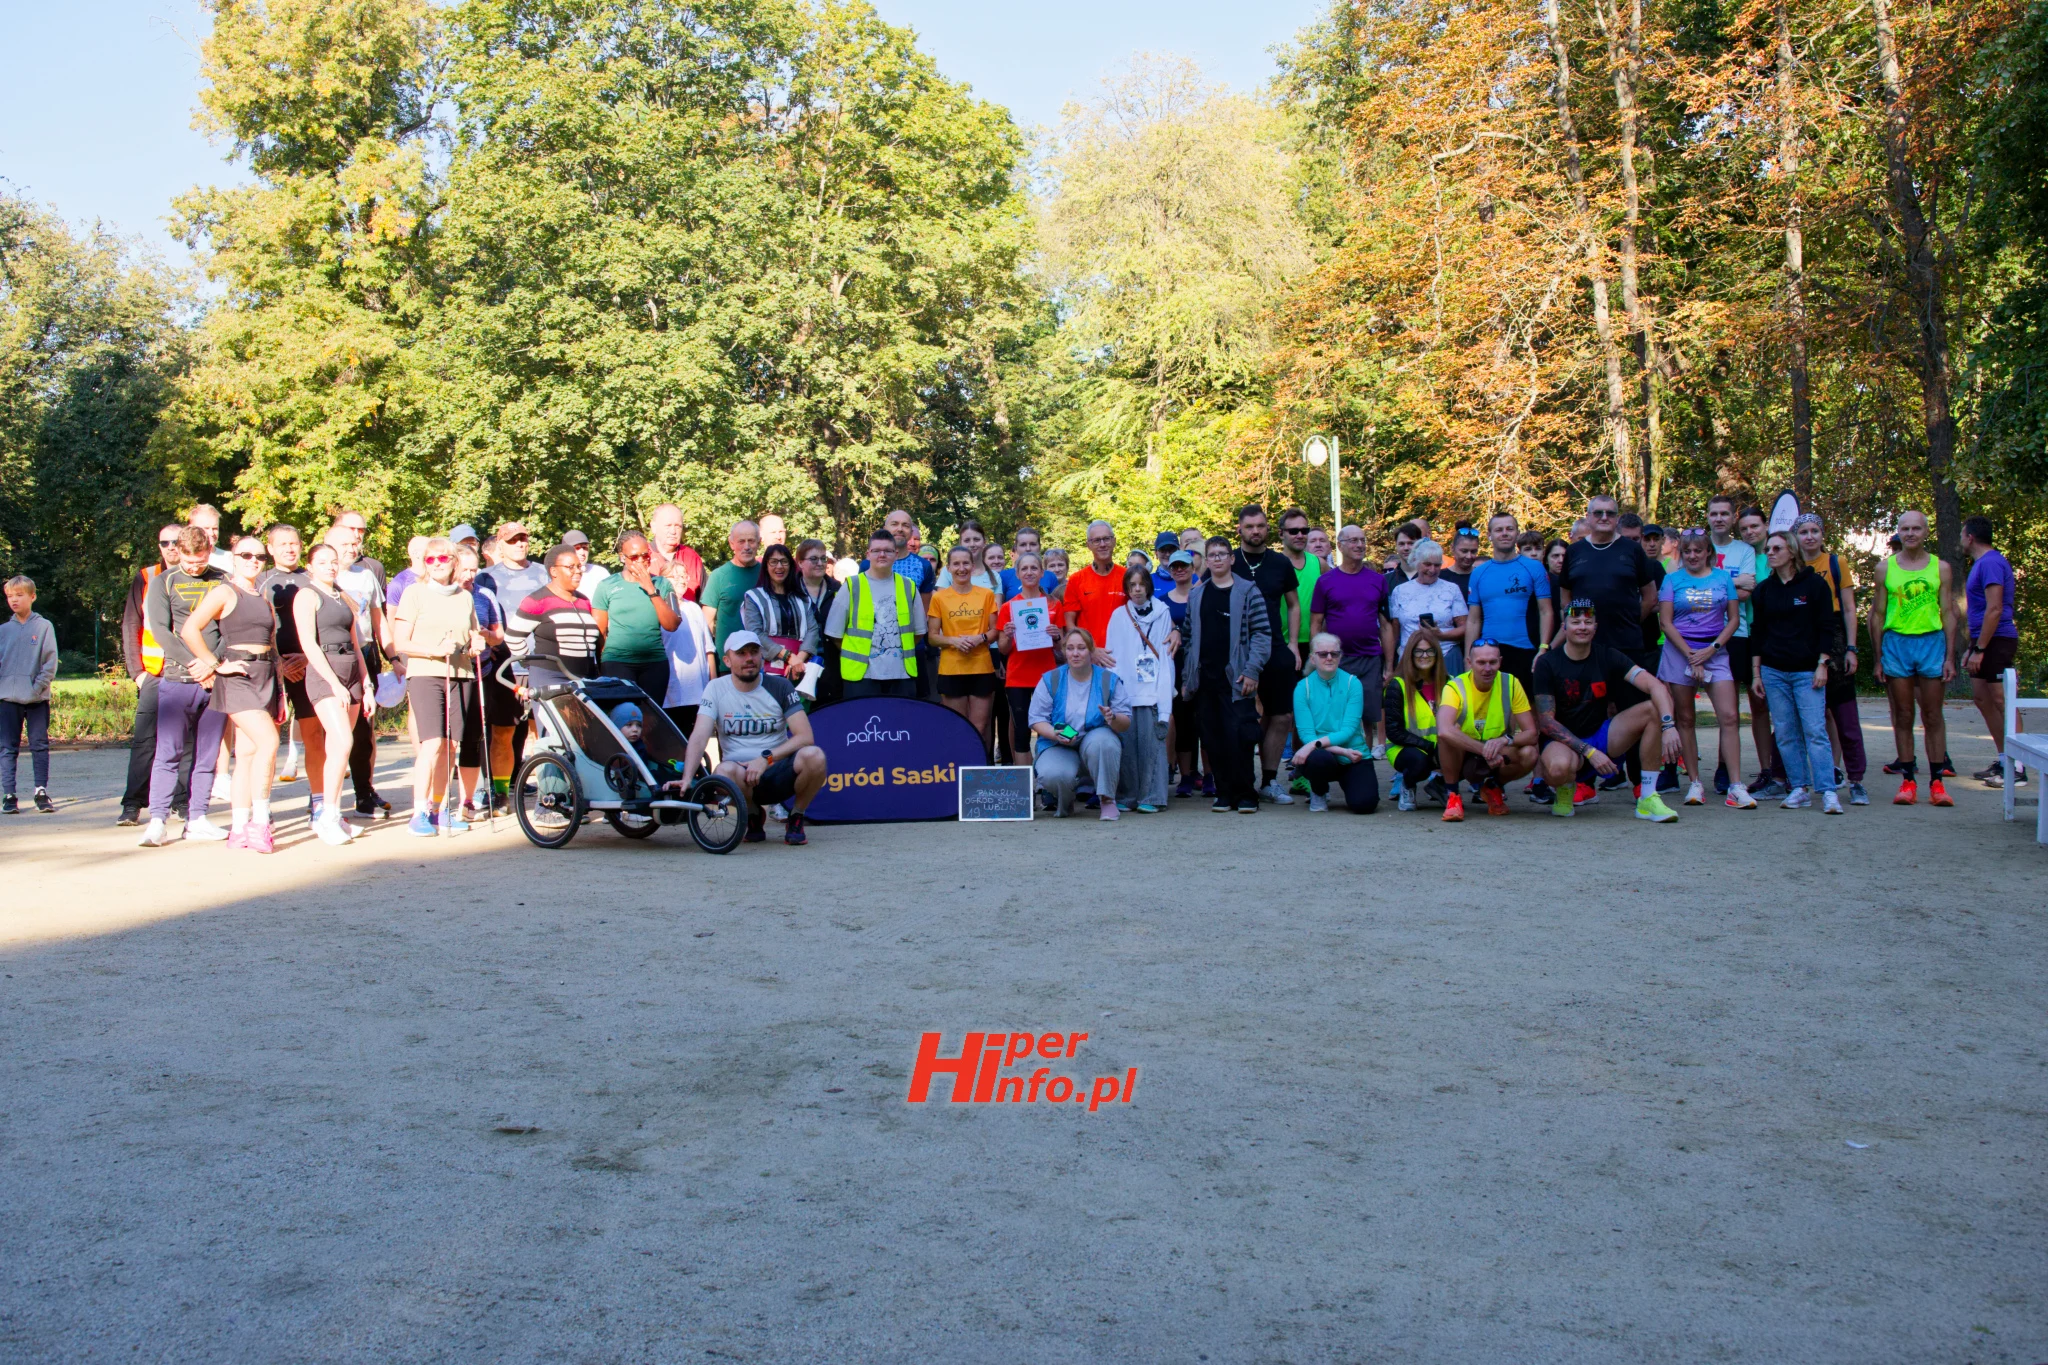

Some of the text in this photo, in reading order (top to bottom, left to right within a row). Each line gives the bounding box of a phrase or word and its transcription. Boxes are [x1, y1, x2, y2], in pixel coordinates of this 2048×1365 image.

[1504, 586, 1527, 595] KAPS
[948, 602, 984, 619] parkrun
[846, 715, 910, 747] parkrun
[891, 762, 956, 785] Saski
